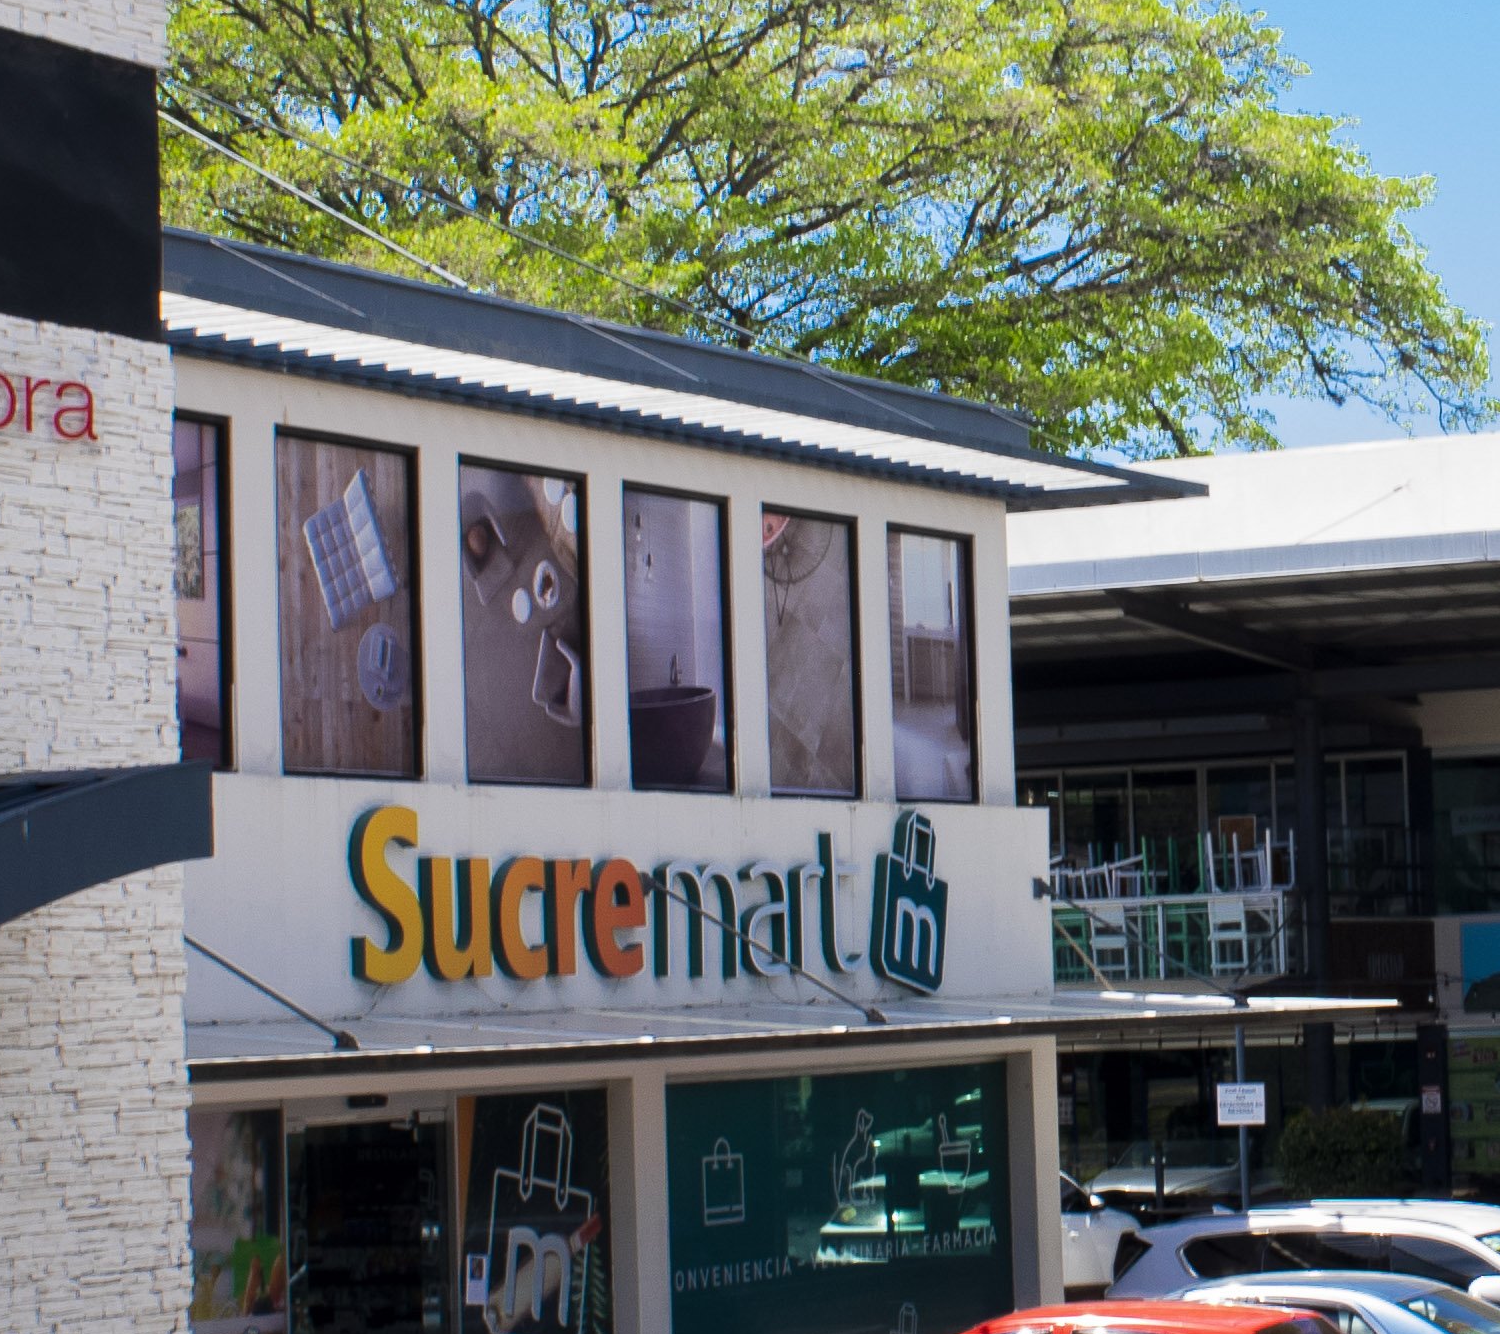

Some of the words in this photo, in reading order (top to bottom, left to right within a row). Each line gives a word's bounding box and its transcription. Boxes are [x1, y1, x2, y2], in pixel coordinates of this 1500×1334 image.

[350, 805, 863, 985] Sucremart
[674, 1255, 793, 1293] ONVENIENCIA
[922, 1225, 998, 1255] FARMACIA
